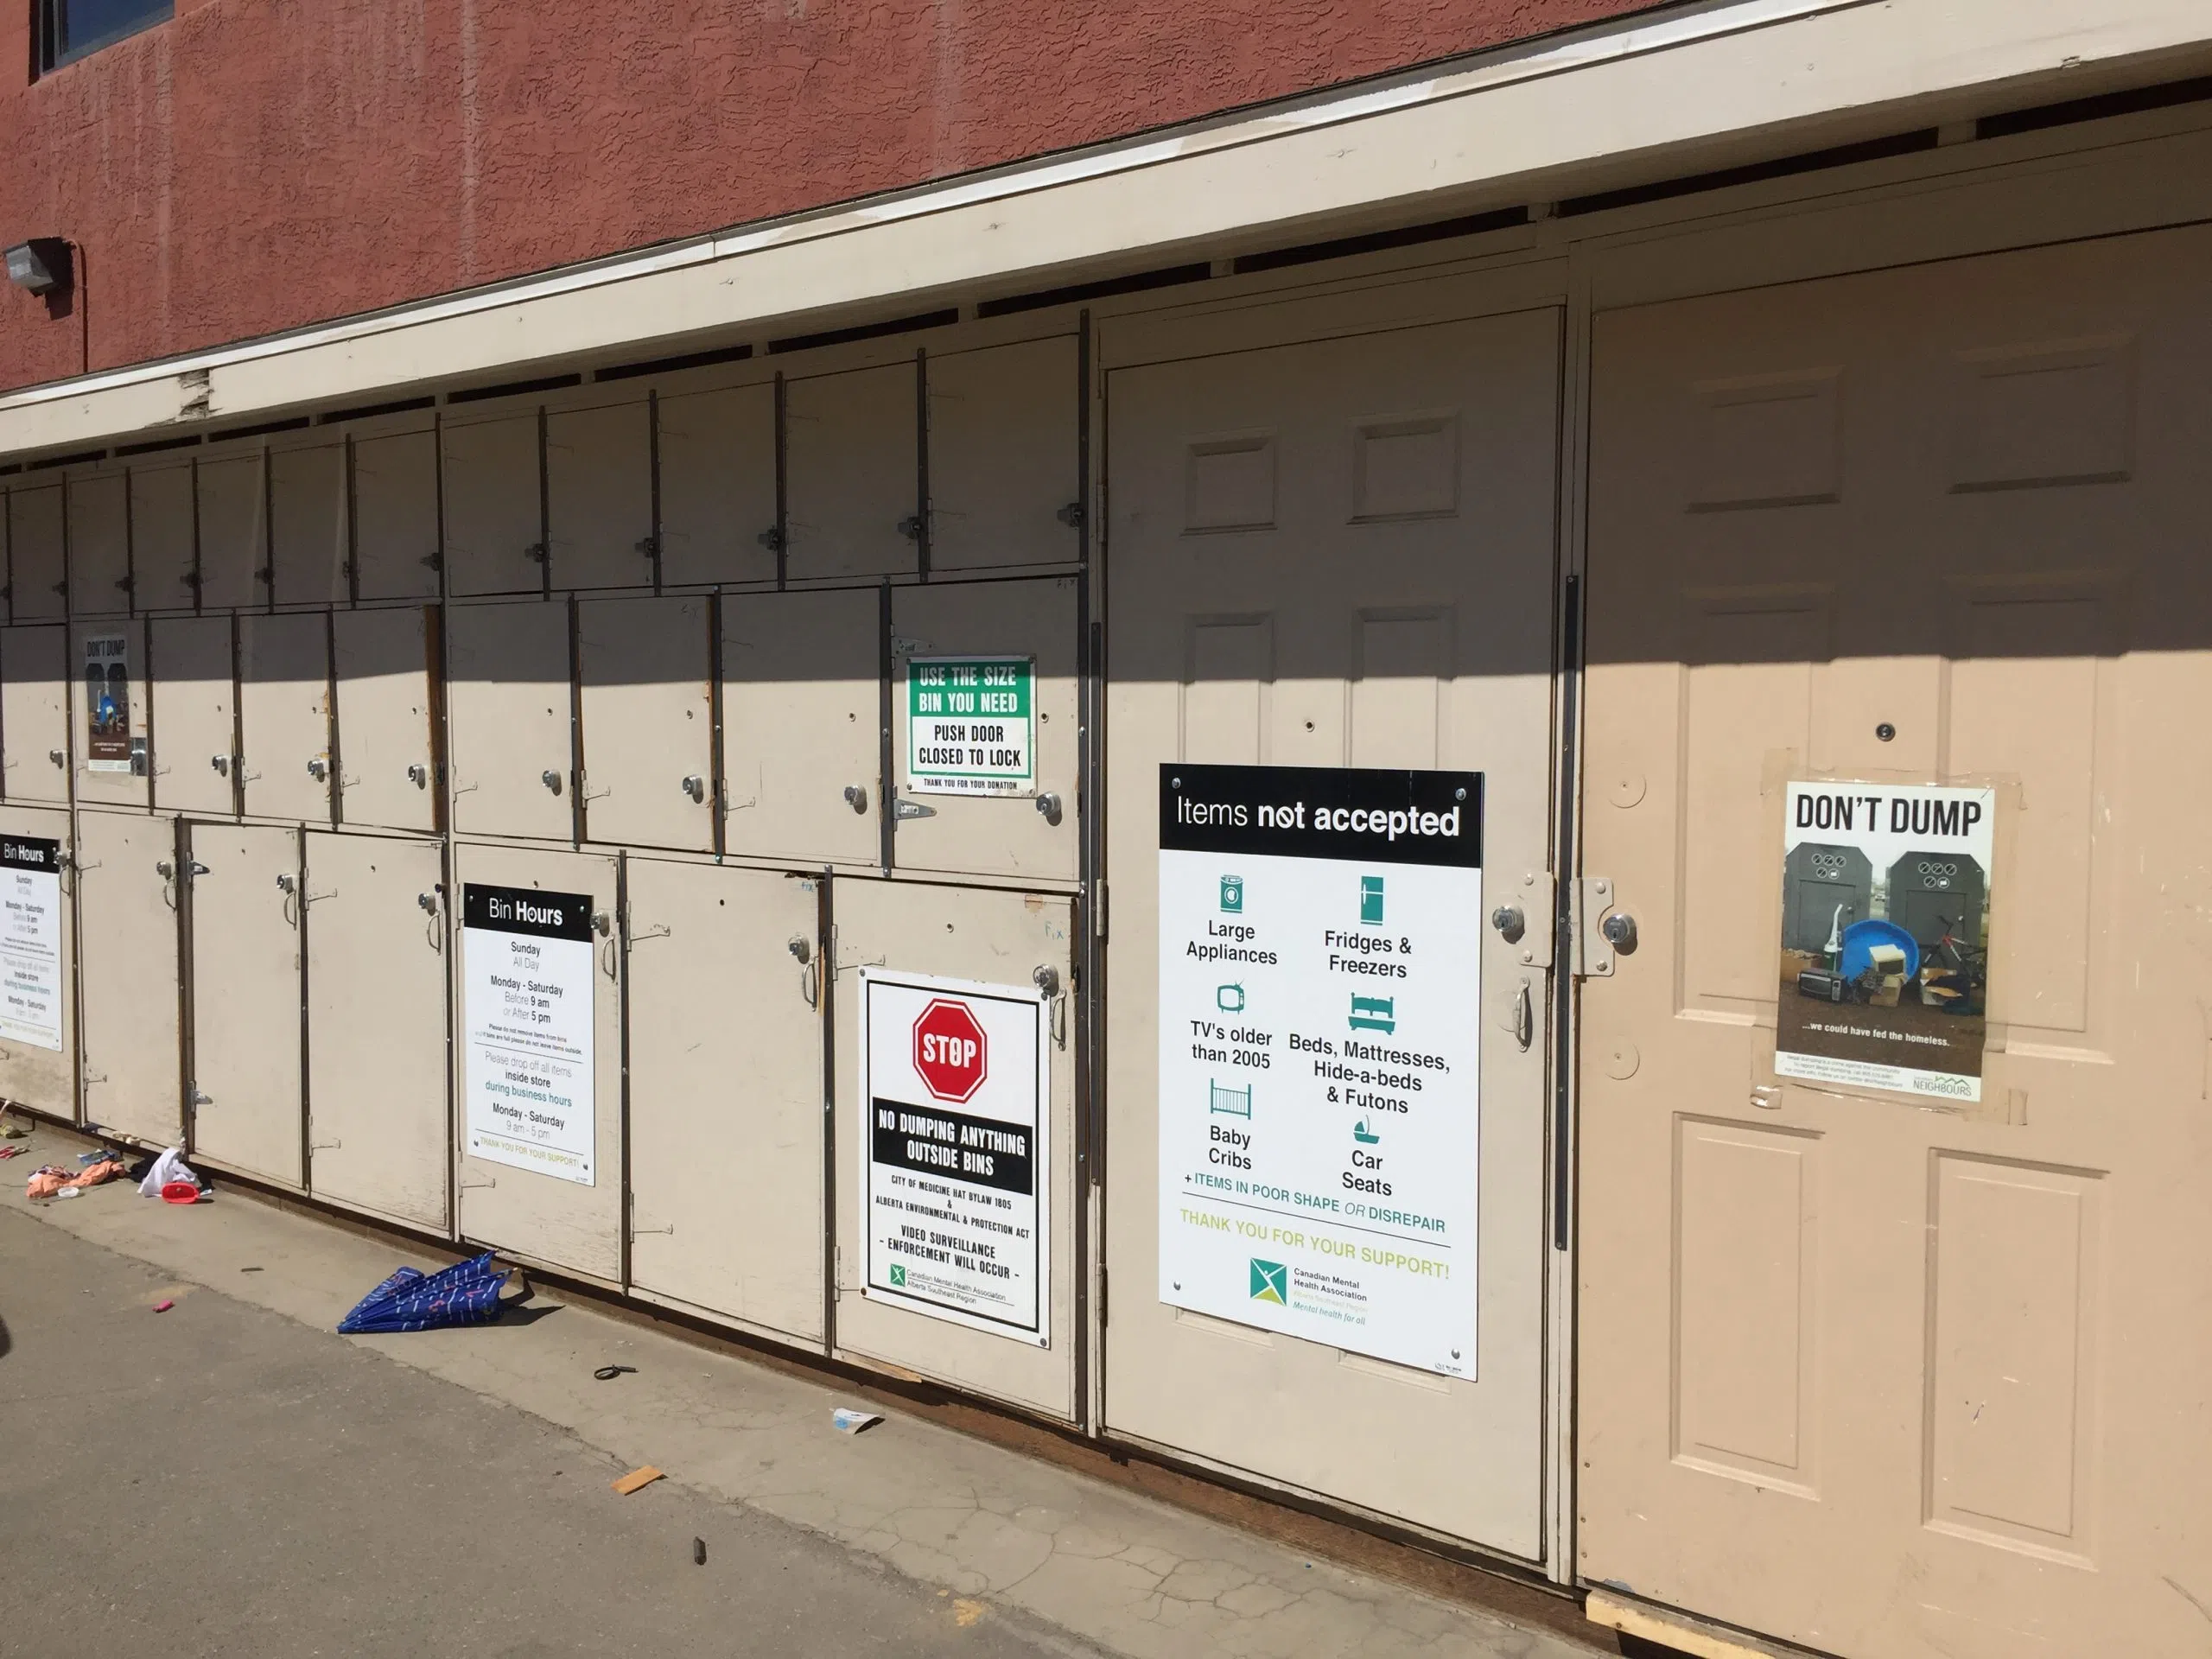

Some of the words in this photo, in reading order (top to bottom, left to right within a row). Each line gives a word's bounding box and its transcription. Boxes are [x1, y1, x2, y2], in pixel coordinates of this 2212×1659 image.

[87, 640, 105, 657] DON'T
[107, 639, 124, 657] DUMP
[919, 667, 945, 686] USE
[952, 667, 977, 686] THE
[984, 666, 1016, 686] SIZE
[919, 693, 942, 712] BIN
[948, 693, 974, 712] YOU
[981, 693, 1017, 712] NEED
[935, 725, 965, 741] PUSH
[971, 726, 1004, 742] DOOR
[919, 747, 963, 764] CLOSED
[969, 749, 983, 765] TO
[990, 750, 1020, 766] LOCK
[988, 781, 1017, 790] DONATION
[1178, 796, 1248, 827] Items
[1258, 802, 1305, 828] not
[1314, 806, 1459, 841] accepted
[1796, 794, 1882, 831] DON'T
[1891, 798, 1981, 836] DUMP
[4, 843, 16, 860] Bin
[18, 845, 44, 863] Hours
[490, 898, 512, 919] Bin
[516, 900, 563, 925] Hours
[1209, 920, 1255, 942] Large
[1325, 931, 1392, 953] Fridges
[1399, 938, 1412, 954] &
[512, 942, 540, 957] Sunday
[1186, 941, 1278, 965] Appliances
[513, 957, 523, 967] All
[524, 958, 539, 971] Day
[1329, 955, 1407, 978] Freezers
[491, 976, 521, 991] Monday
[528, 981, 563, 998] Saturday
[505, 991, 529, 1005] Before
[531, 996, 535, 1006] 9
[537, 999, 550, 1008] am
[512, 1007, 530, 1020] After
[531, 1011, 536, 1020] 5
[538, 1014, 550, 1024] pm
[1191, 1020, 1225, 1040] TV's
[1230, 1027, 1272, 1046] older
[1825, 1024, 1847, 1034] could
[1851, 1026, 1871, 1037] have
[1872, 1029, 1886, 1039] fed
[1889, 1031, 1903, 1041] the
[1905, 1033, 1950, 1047] homeless.
[923, 1033, 976, 1068] STOP
[1192, 1044, 1227, 1063] than
[1232, 1050, 1270, 1069] 2005
[1289, 1033, 1338, 1058] Beds,
[1344, 1040, 1450, 1073] Mattresses,
[486, 1051, 509, 1065] Please
[512, 1057, 527, 1070] drop
[530, 1060, 538, 1071] off
[551, 1066, 572, 1078] items
[1313, 1060, 1422, 1091] Hide-a-beds
[505, 1071, 529, 1084] inside
[531, 1076, 550, 1088] store
[1913, 1080, 1972, 1096] NEIGHBOURS
[486, 1080, 509, 1096] during
[512, 1087, 547, 1102] business
[549, 1095, 572, 1107] hours
[1327, 1086, 1339, 1103] &
[1345, 1089, 1408, 1113] Futons
[493, 1103, 523, 1120] Monday
[530, 1111, 564, 1130] Saturday
[506, 1121, 512, 1130] 9
[513, 1123, 524, 1133] am
[531, 1127, 536, 1136] 5
[538, 1129, 550, 1140] pm
[879, 1109, 895, 1129] NO
[900, 1113, 955, 1142] DUMPING
[960, 1125, 1025, 1157] ANYTHING
[1211, 1125, 1250, 1150] Baby
[480, 1137, 499, 1147] THANK
[502, 1142, 514, 1152] YOU
[515, 1146, 527, 1154] FOR
[530, 1149, 546, 1160] YOUR
[907, 1141, 958, 1169] OUTSIDE
[963, 1152, 994, 1176] BINS
[1209, 1147, 1252, 1170] Cribs
[1351, 1150, 1382, 1170] Car
[892, 1175, 906, 1185] CITY
[909, 1179, 916, 1188] OF
[919, 1181, 950, 1196] MEDICINE
[953, 1189, 966, 1199] HAT
[969, 1192, 992, 1205] BYLAW
[995, 1198, 1012, 1210] 1805
[1342, 1172, 1392, 1197] Seats
[1195, 1173, 1232, 1191] ITEMS
[1236, 1181, 1249, 1193] IN
[1253, 1185, 1289, 1202] POOR
[1294, 1192, 1339, 1211] SHAPE
[1344, 1202, 1365, 1217] OR
[1369, 1207, 1445, 1233] DISREPAIR
[876, 1196, 903, 1209] ALBERTA
[906, 1202, 960, 1223] ENVIRONMENTAL
[963, 1216, 968, 1224] &
[971, 1217, 1013, 1235] PROTECTION
[1016, 1228, 1029, 1239] ACT
[901, 1225, 925, 1241] VIDEO
[930, 1232, 995, 1258] SURVEILLANCE
[1179, 1209, 1230, 1232] THANK
[1236, 1220, 1267, 1240] YOU
[1273, 1229, 1305, 1248] FOR
[1310, 1236, 1355, 1259] YOUR
[1361, 1248, 1450, 1279] SUPPORT!
[888, 1238, 950, 1263] ENFORCEMENT
[955, 1254, 975, 1271] WILL
[980, 1261, 1010, 1279] OCCUR
[907, 1269, 932, 1282] Canadian
[934, 1275, 951, 1287] Mental
[954, 1281, 972, 1291] Health
[973, 1286, 1006, 1301] Association
[1294, 1268, 1330, 1282] Canadian
[1332, 1276, 1359, 1289] Mental
[1294, 1279, 1319, 1292] Health
[1321, 1285, 1367, 1301] Association
[907, 1281, 926, 1292] Alberta
[927, 1285, 955, 1299] Southeast
[957, 1293, 976, 1305] Region
[1293, 1301, 1318, 1313] Mental
[1319, 1307, 1343, 1319] health
[1344, 1313, 1355, 1323] for
[1357, 1317, 1365, 1325] all
